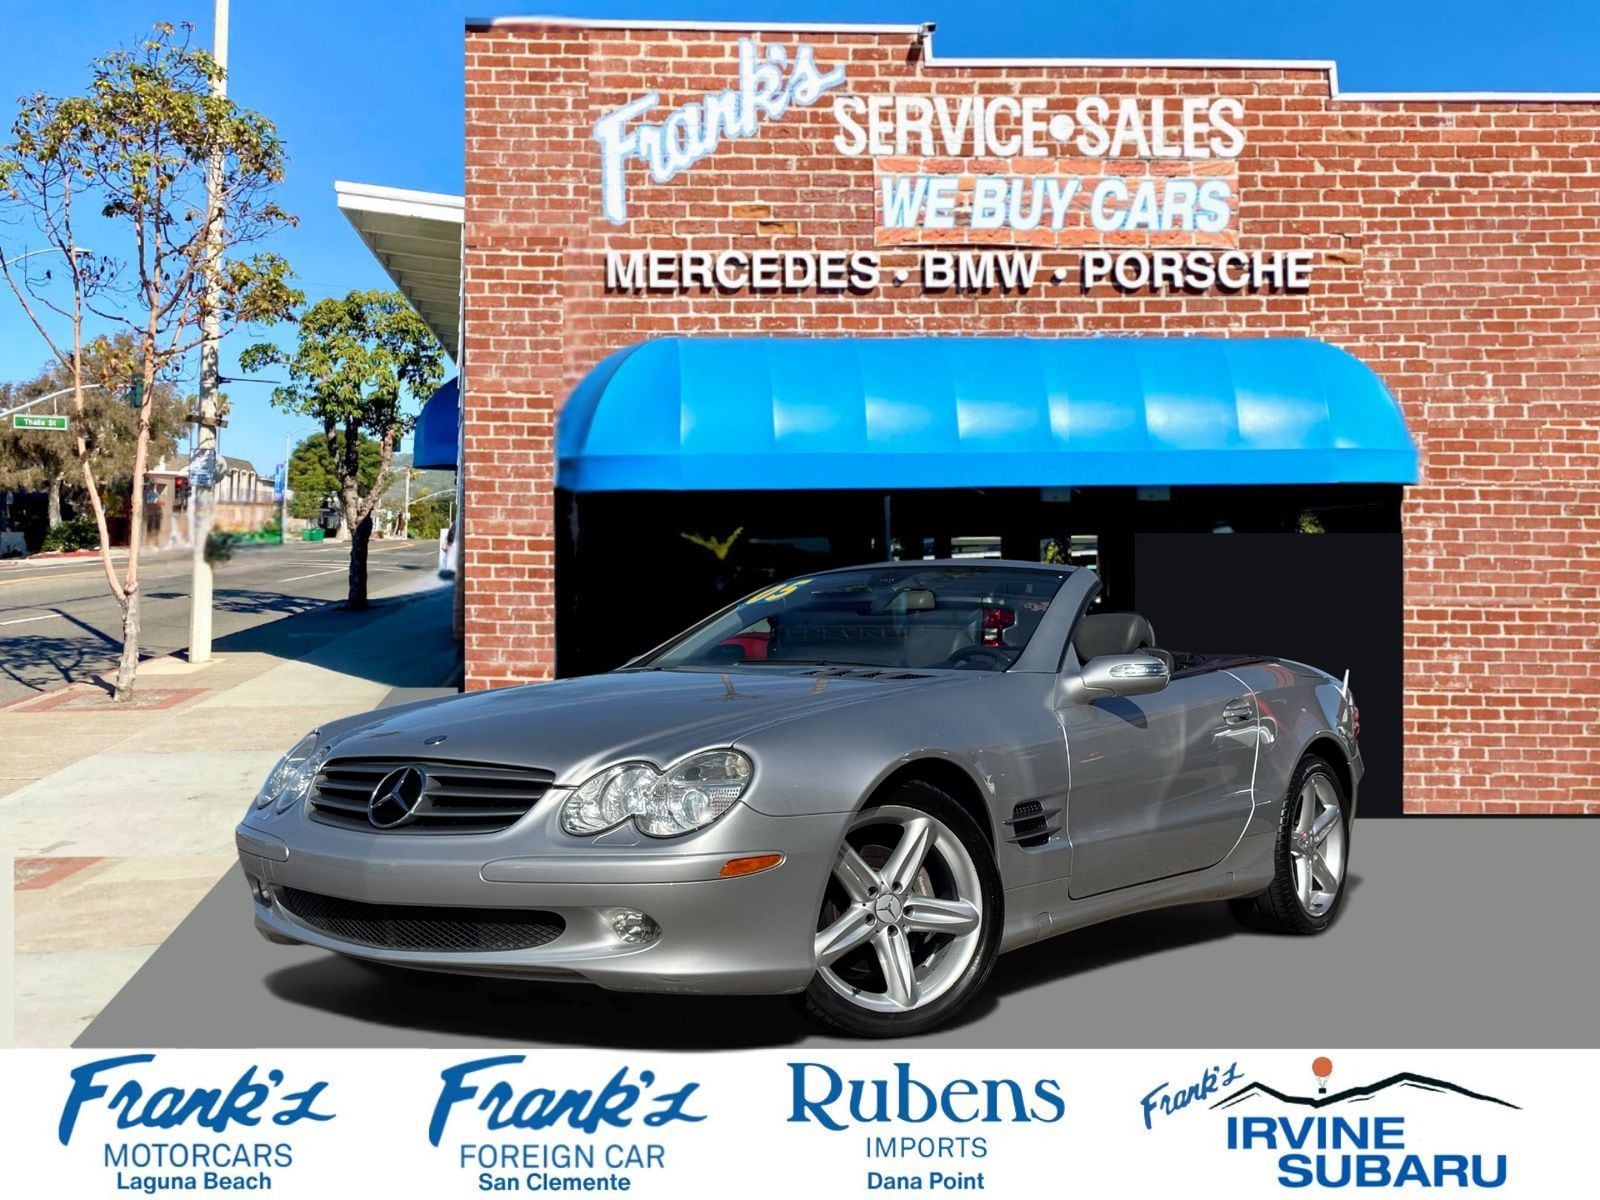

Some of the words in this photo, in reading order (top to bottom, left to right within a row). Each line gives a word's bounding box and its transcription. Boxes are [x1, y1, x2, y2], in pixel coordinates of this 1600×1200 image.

[593, 37, 846, 226] Frank's
[833, 96, 1049, 157] SERVICE
[1075, 96, 1246, 160] SALES
[880, 174, 957, 230] WE
[969, 174, 1079, 231] BUY
[1090, 174, 1234, 232] CARS
[605, 247, 881, 292] MERCEDES
[922, 249, 1043, 292] BMW
[1081, 247, 1314, 294] PORSCHE
